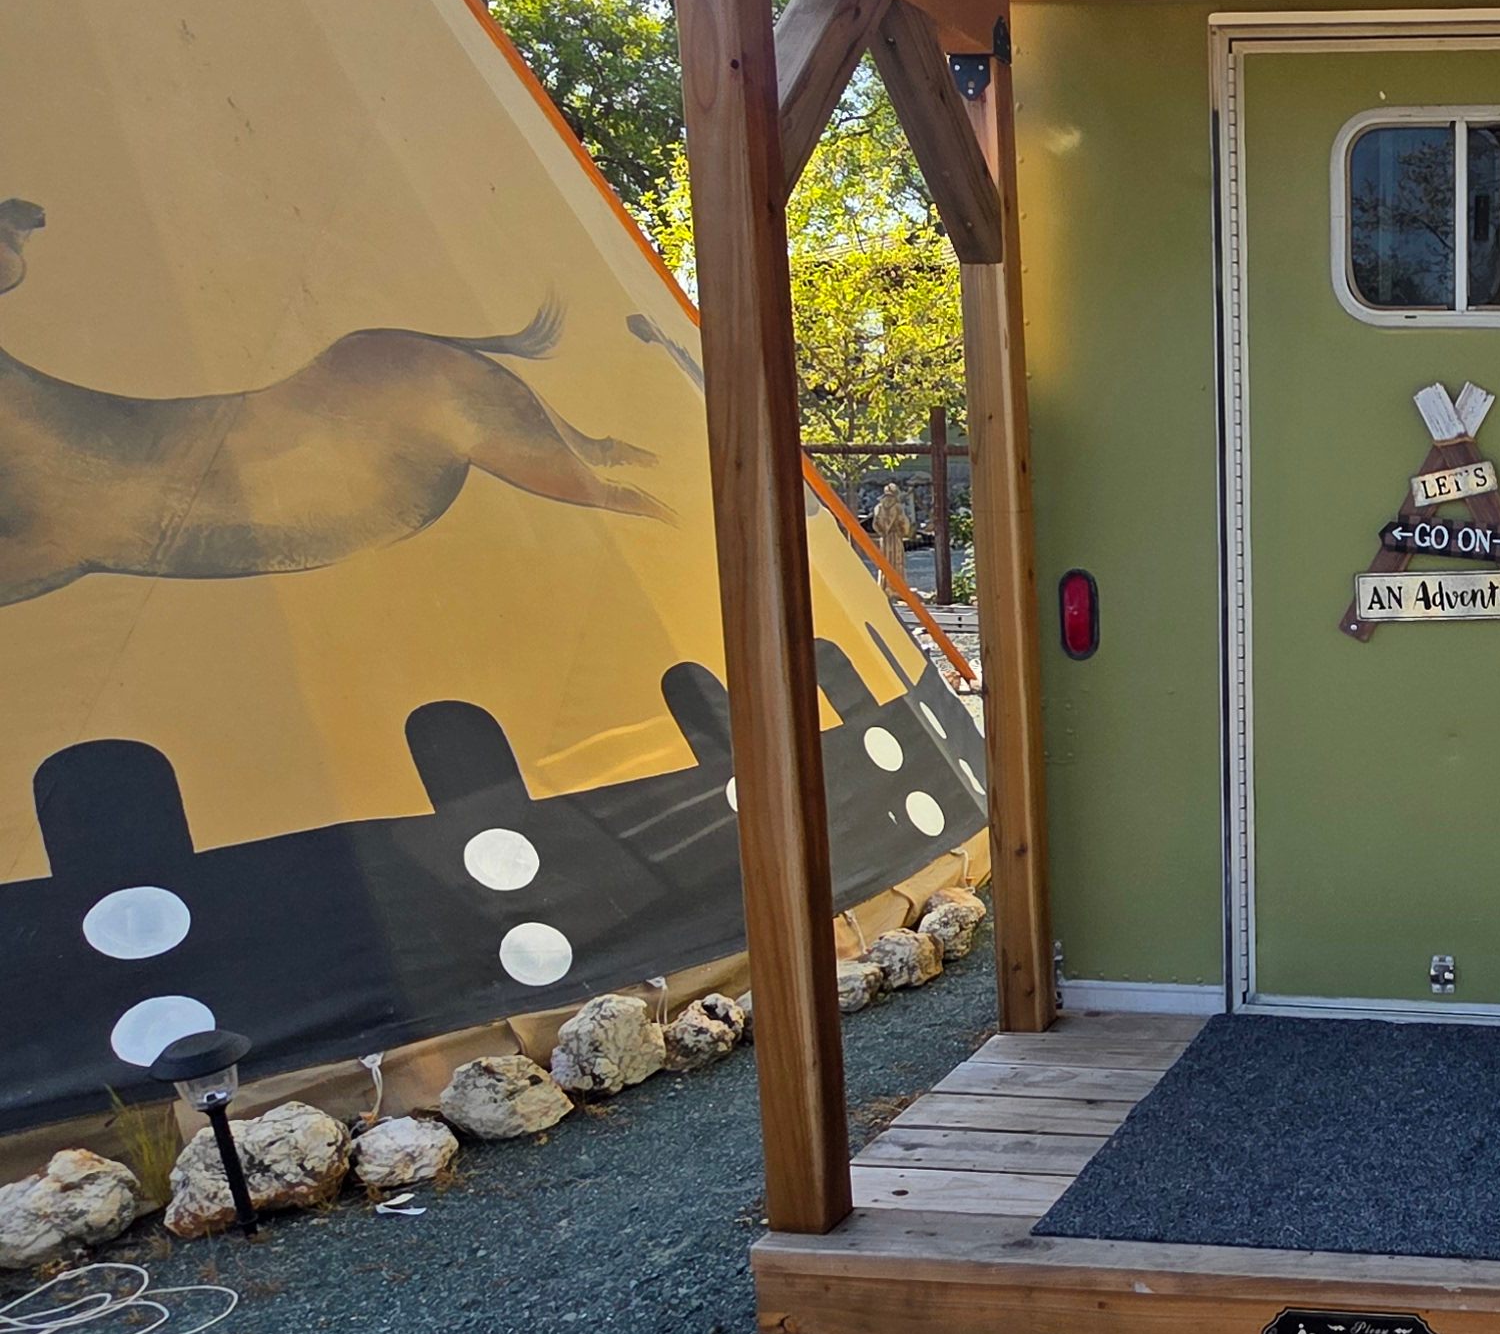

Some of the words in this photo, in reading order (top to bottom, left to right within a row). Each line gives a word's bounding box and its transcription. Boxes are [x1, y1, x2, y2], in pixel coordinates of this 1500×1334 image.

[1421, 467, 1488, 499] LET'S
[1414, 522, 1449, 549] GO
[1457, 527, 1492, 553] ON
[1367, 586, 1403, 610] AN
